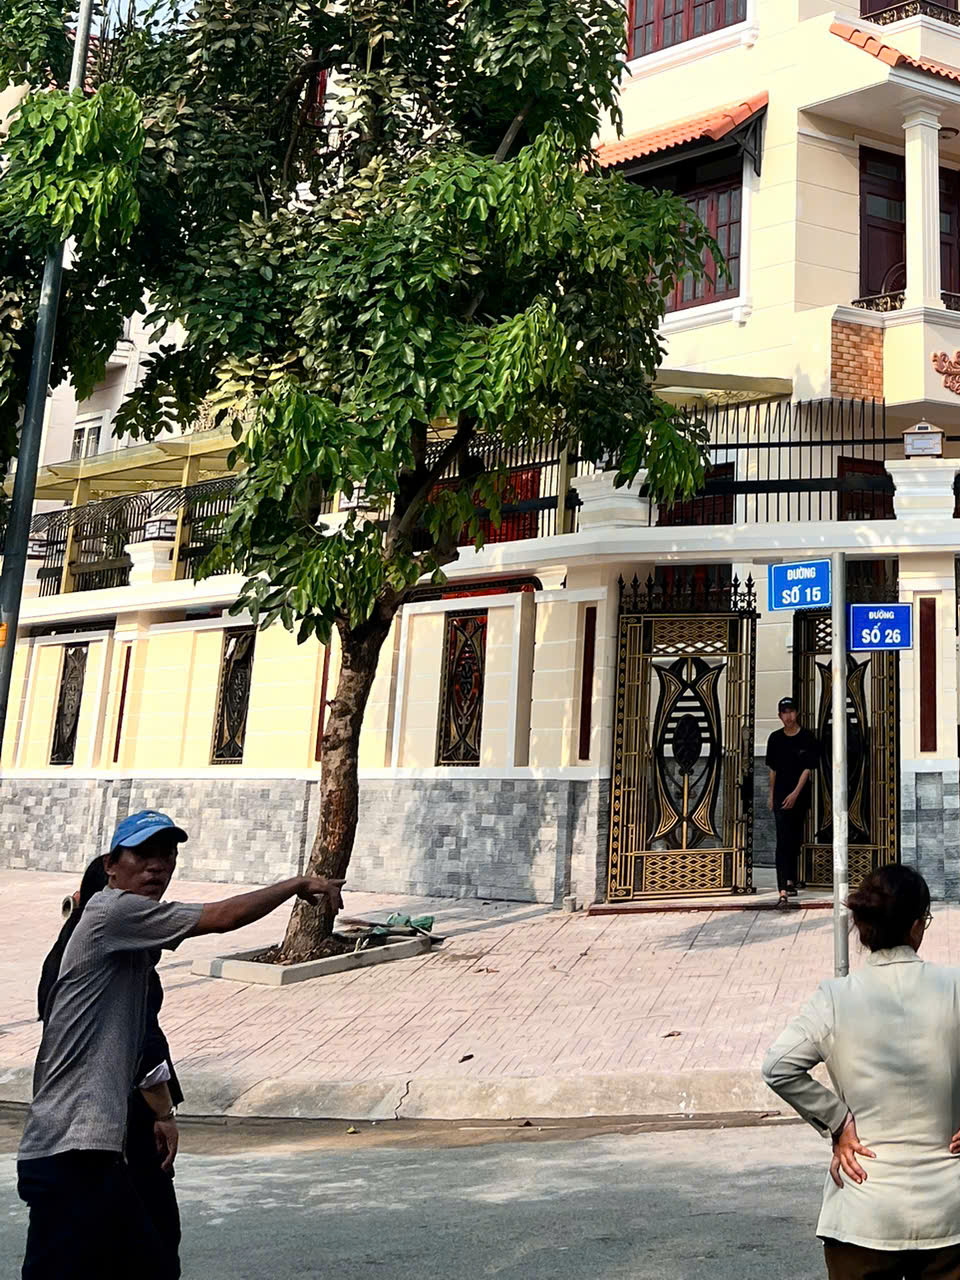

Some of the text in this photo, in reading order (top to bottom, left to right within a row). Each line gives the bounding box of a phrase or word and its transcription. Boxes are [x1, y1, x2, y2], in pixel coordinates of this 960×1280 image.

[787, 566, 816, 580] ĐƯỜNG
[782, 584, 821, 604] SỐ 15
[868, 609, 895, 620] ĐƯỜNG
[861, 622, 901, 644] SỐ 26
